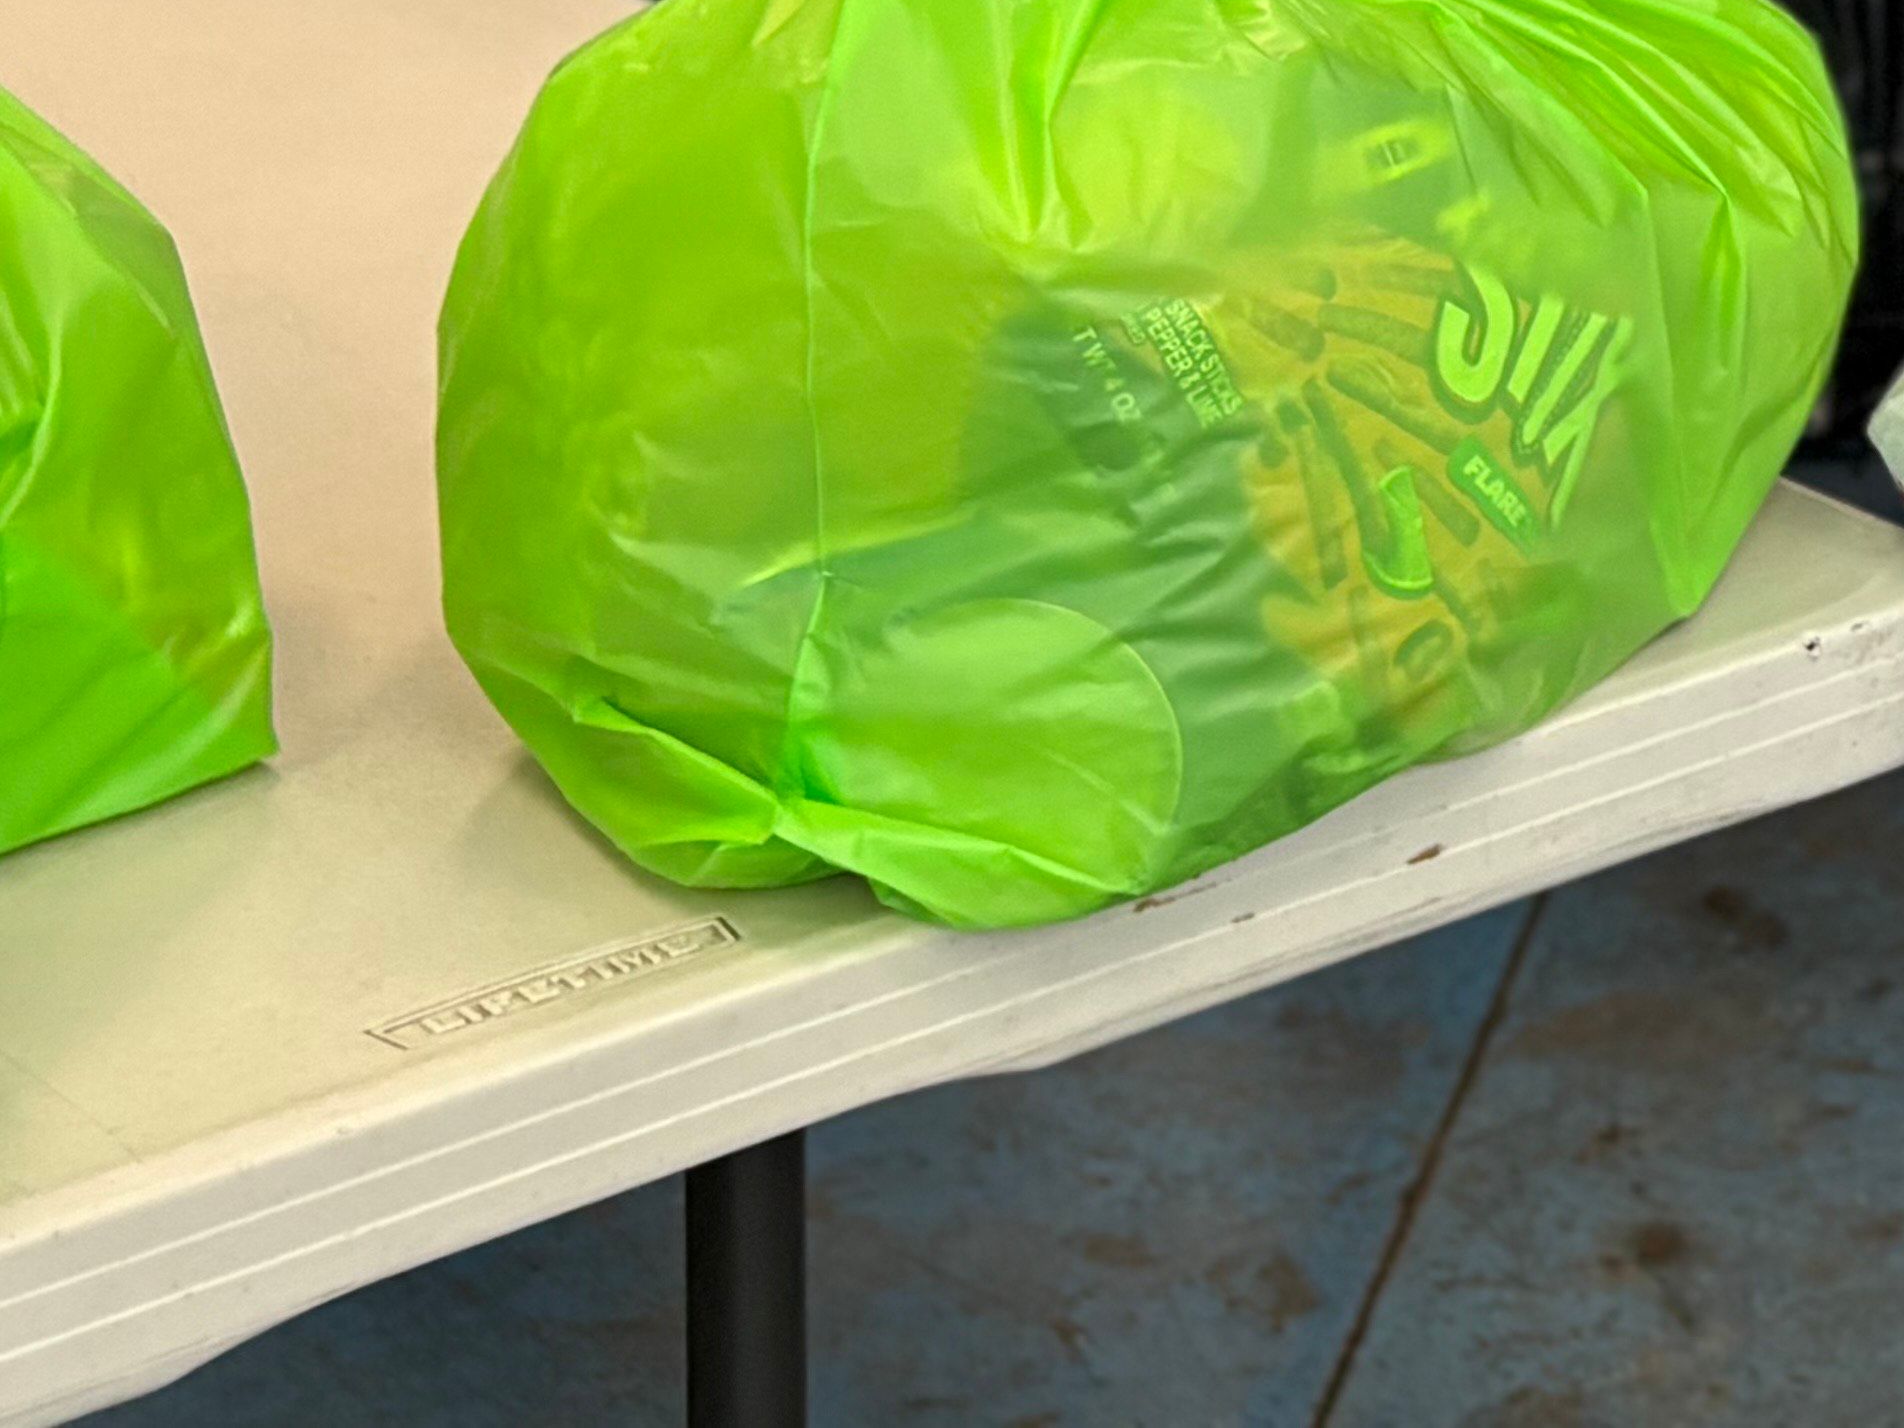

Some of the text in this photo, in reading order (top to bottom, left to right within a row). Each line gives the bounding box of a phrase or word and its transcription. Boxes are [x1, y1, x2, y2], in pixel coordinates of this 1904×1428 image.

[1142, 306, 1194, 378] PEPPER
[1165, 298, 1213, 361] SNACK
[420, 934, 701, 1035] LIFETIME
